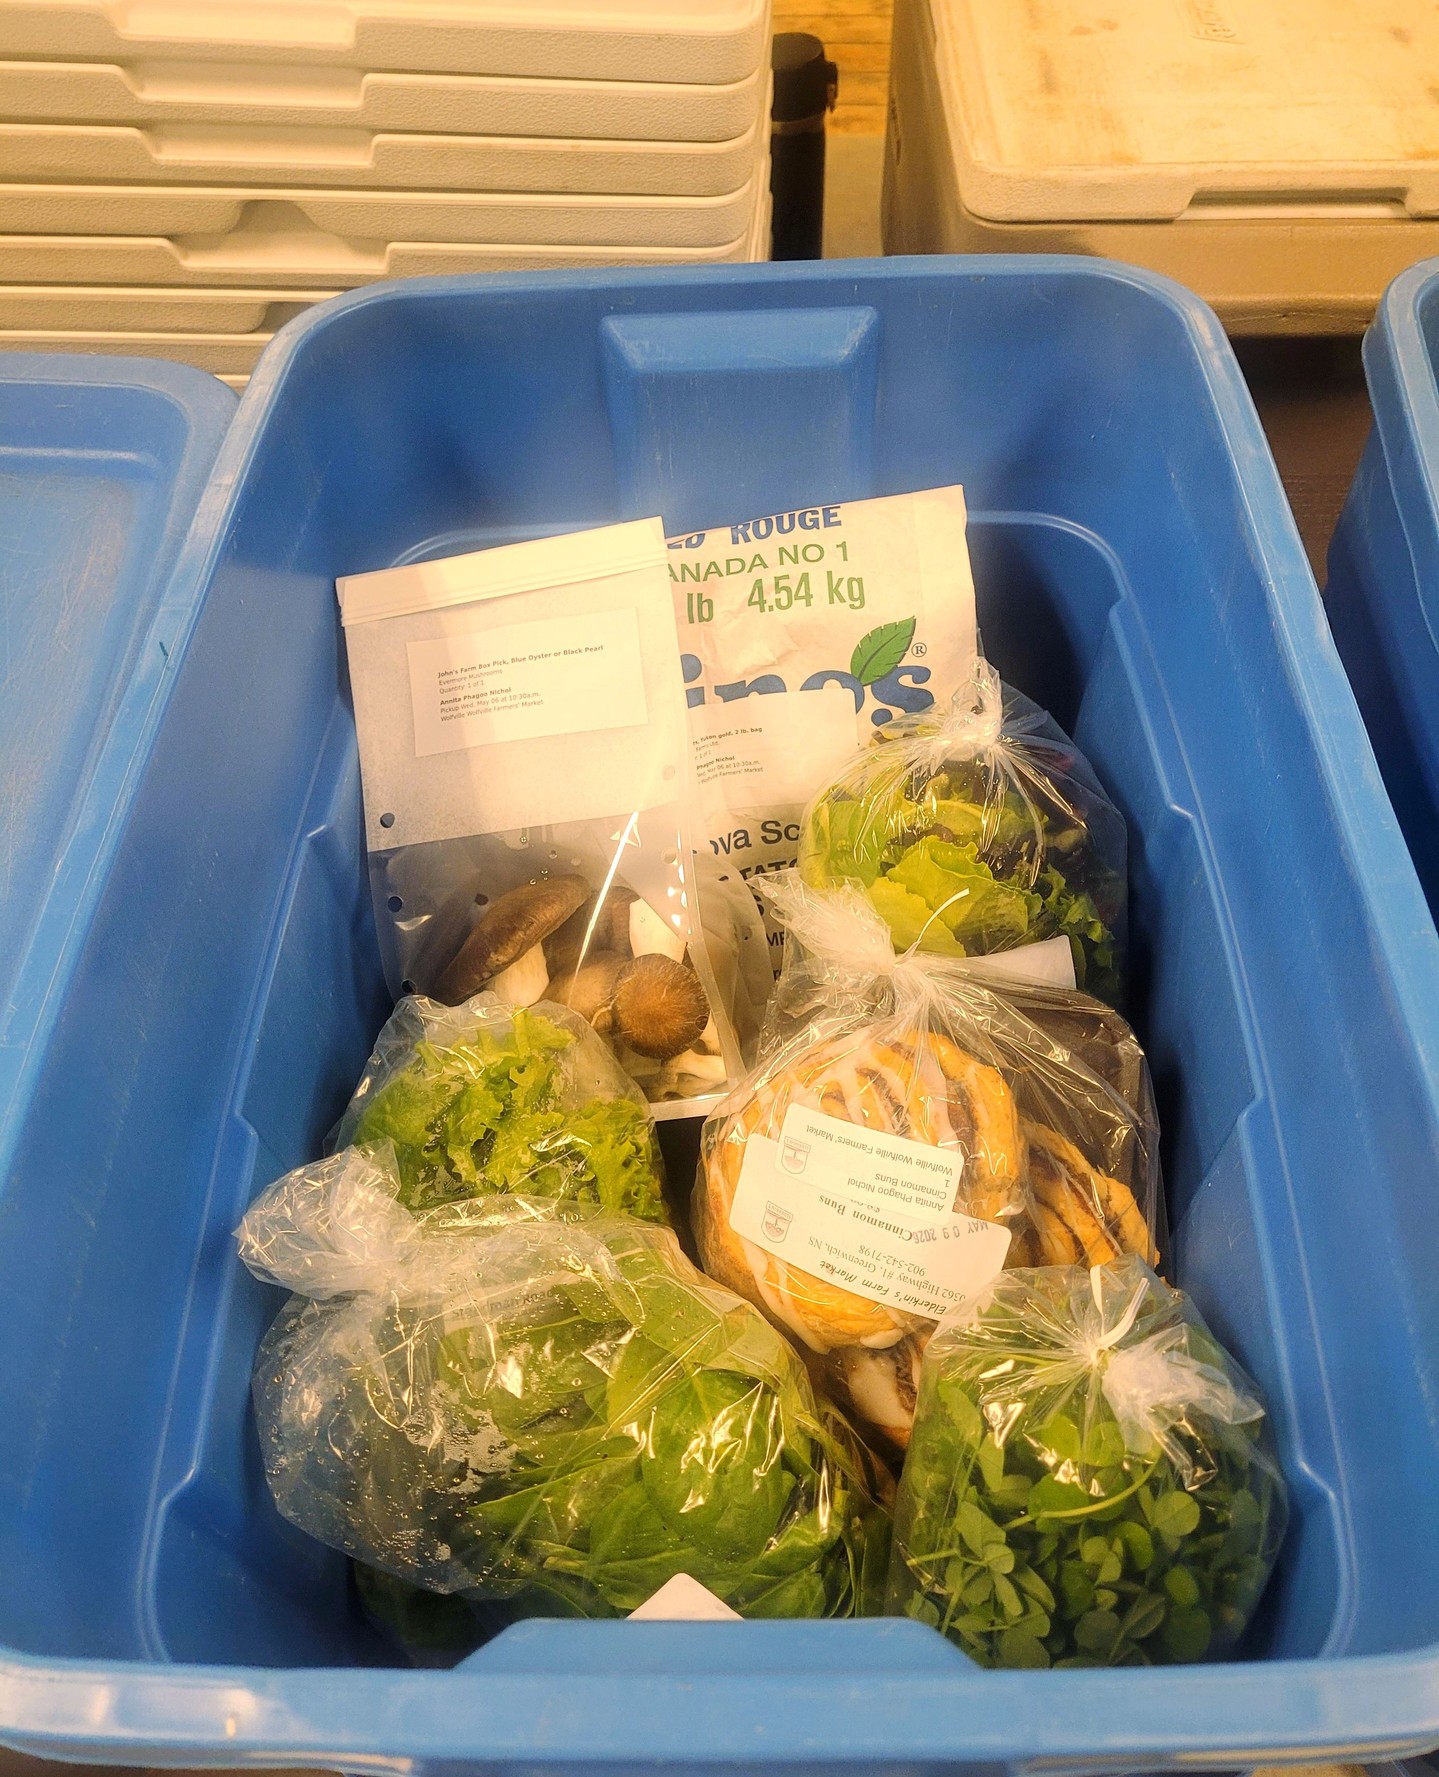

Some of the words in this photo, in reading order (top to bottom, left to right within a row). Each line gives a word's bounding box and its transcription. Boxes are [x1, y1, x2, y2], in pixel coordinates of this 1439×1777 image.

[731, 506, 841, 544] ROUGE
[778, 543, 825, 565] NO
[836, 541, 848, 562] 1
[687, 592, 714, 624] lb
[747, 572, 813, 613] 4.54
[826, 570, 866, 610] kg
[438, 670, 458, 678] John's
[528, 652, 551, 661] Oyster
[563, 648, 583, 656] Black
[439, 676, 467, 686] Evermore
[469, 669, 502, 679] Mushrooms
[440, 697, 462, 705] Annita
[463, 692, 488, 701] Phagoo
[490, 687, 512, 696] Nichol
[441, 706, 460, 714] Pickup
[441, 713, 465, 722] Wolfville
[467, 708, 492, 717] Wolfville
[522, 699, 544, 707] Market
[806, 1125, 834, 1141] Market
[834, 1136, 875, 1155] Farmers'
[875, 1147, 913, 1165] Wolfville
[915, 1158, 953, 1176] Wolfville
[847, 1177, 875, 1193] Nichol
[875, 1173, 898, 1186] Buns
[945, 1179, 950, 1188] 1
[877, 1186, 913, 1203] Phagoo
[901, 1180, 947, 1199] Cinnamon
[818, 1195, 846, 1216] Buns
[916, 1197, 945, 1211] Annita
[852, 1210, 913, 1242] Cinnamon
[967, 1219, 989, 1234] MAY
[808, 1235, 823, 1251] NS
[912, 1228, 937, 1244] 2026
[858, 1245, 926, 1277] 902-542-7198
[819, 1260, 858, 1283] Market
[861, 1278, 890, 1296] Farm
[897, 1273, 939, 1296] Highway
[895, 1290, 947, 1315] Elderkin's
